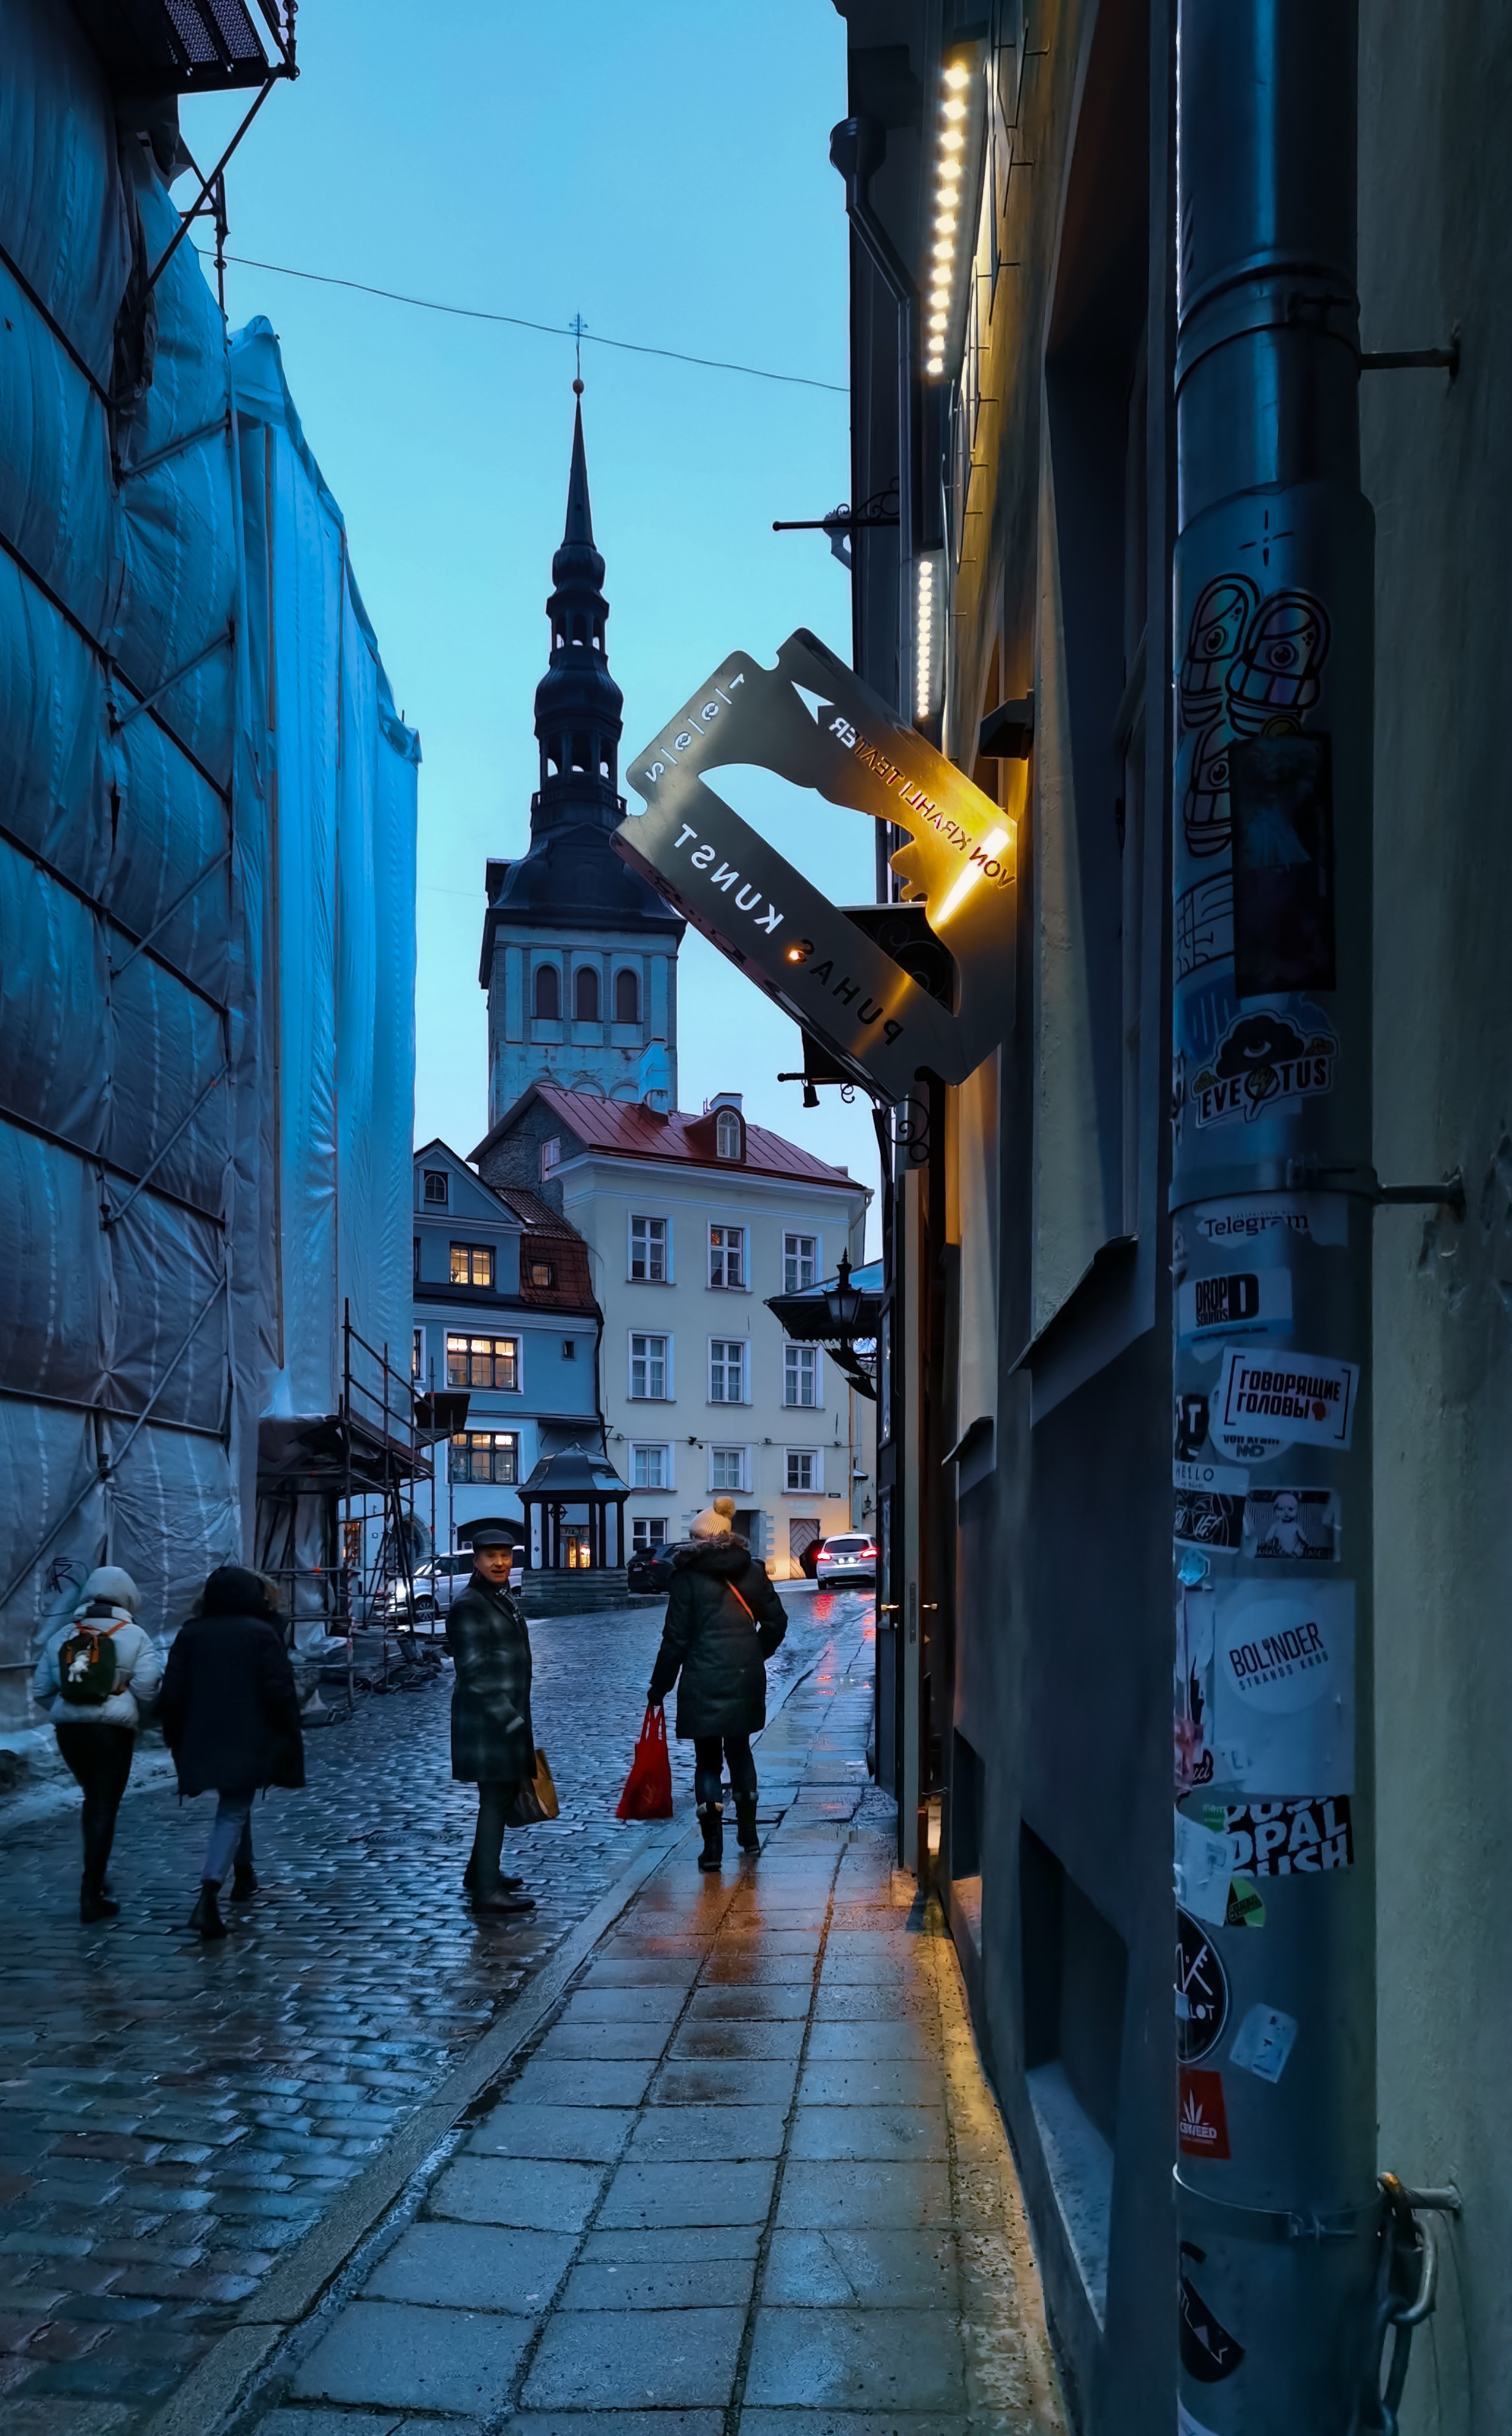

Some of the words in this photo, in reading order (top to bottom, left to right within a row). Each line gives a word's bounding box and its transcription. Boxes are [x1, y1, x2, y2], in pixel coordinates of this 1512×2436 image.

[1196, 1276, 1228, 1311] DROP
[1240, 1369, 1341, 1402] ГОВОРЯЩИЕ
[1236, 1392, 1310, 1419] ГОЛОВЫ
[1175, 1464, 1214, 1482] HELLO
[1229, 1622, 1324, 1678] BOLINDER
[1238, 1663, 1293, 1691] STRANDS
